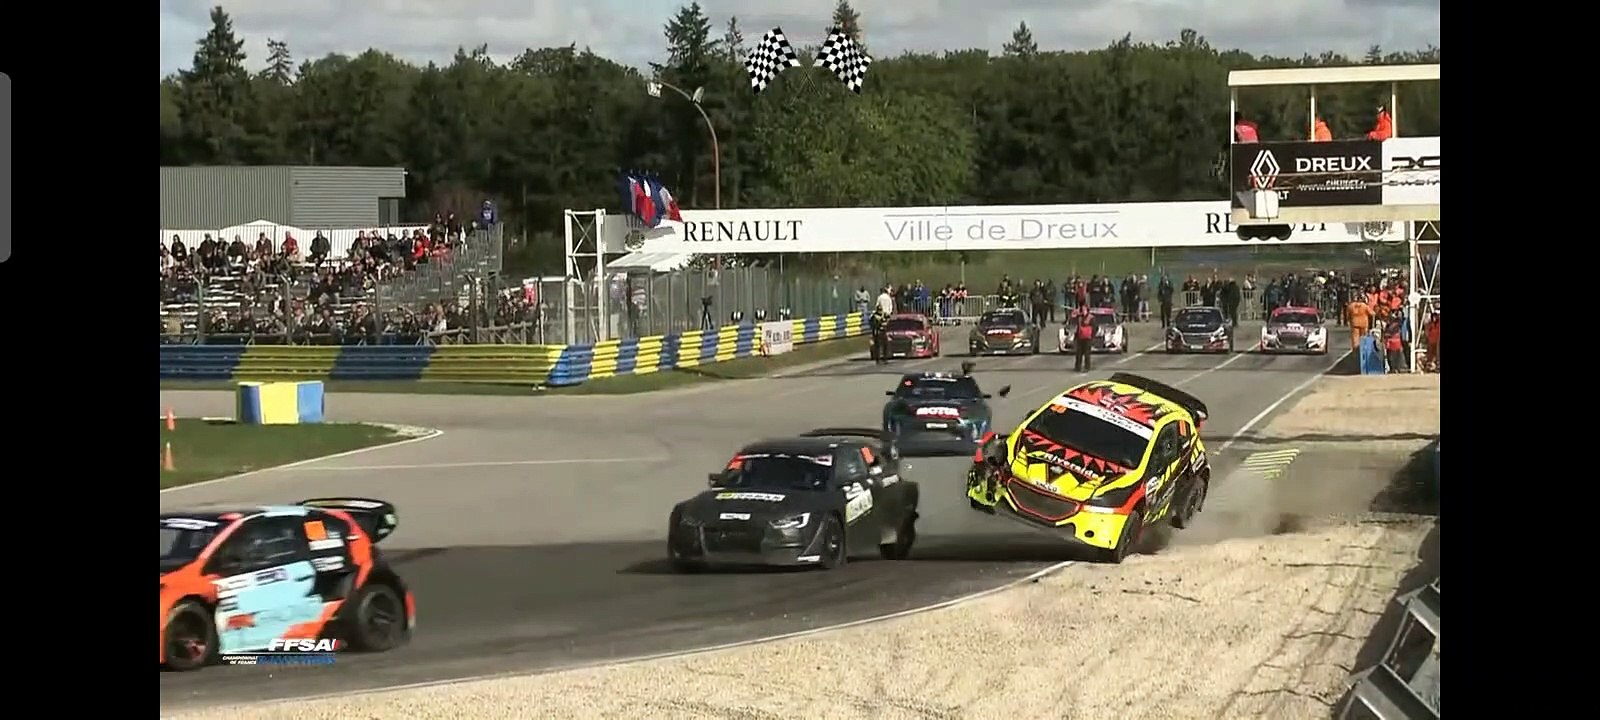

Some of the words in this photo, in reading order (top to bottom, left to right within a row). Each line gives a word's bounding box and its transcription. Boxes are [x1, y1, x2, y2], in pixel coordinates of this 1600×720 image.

[1296, 156, 1372, 172] DREUX
[682, 220, 804, 242] RENAULT
[884, 220, 953, 241] Ville
[967, 219, 1006, 240] de
[1021, 218, 1119, 239] Dreux
